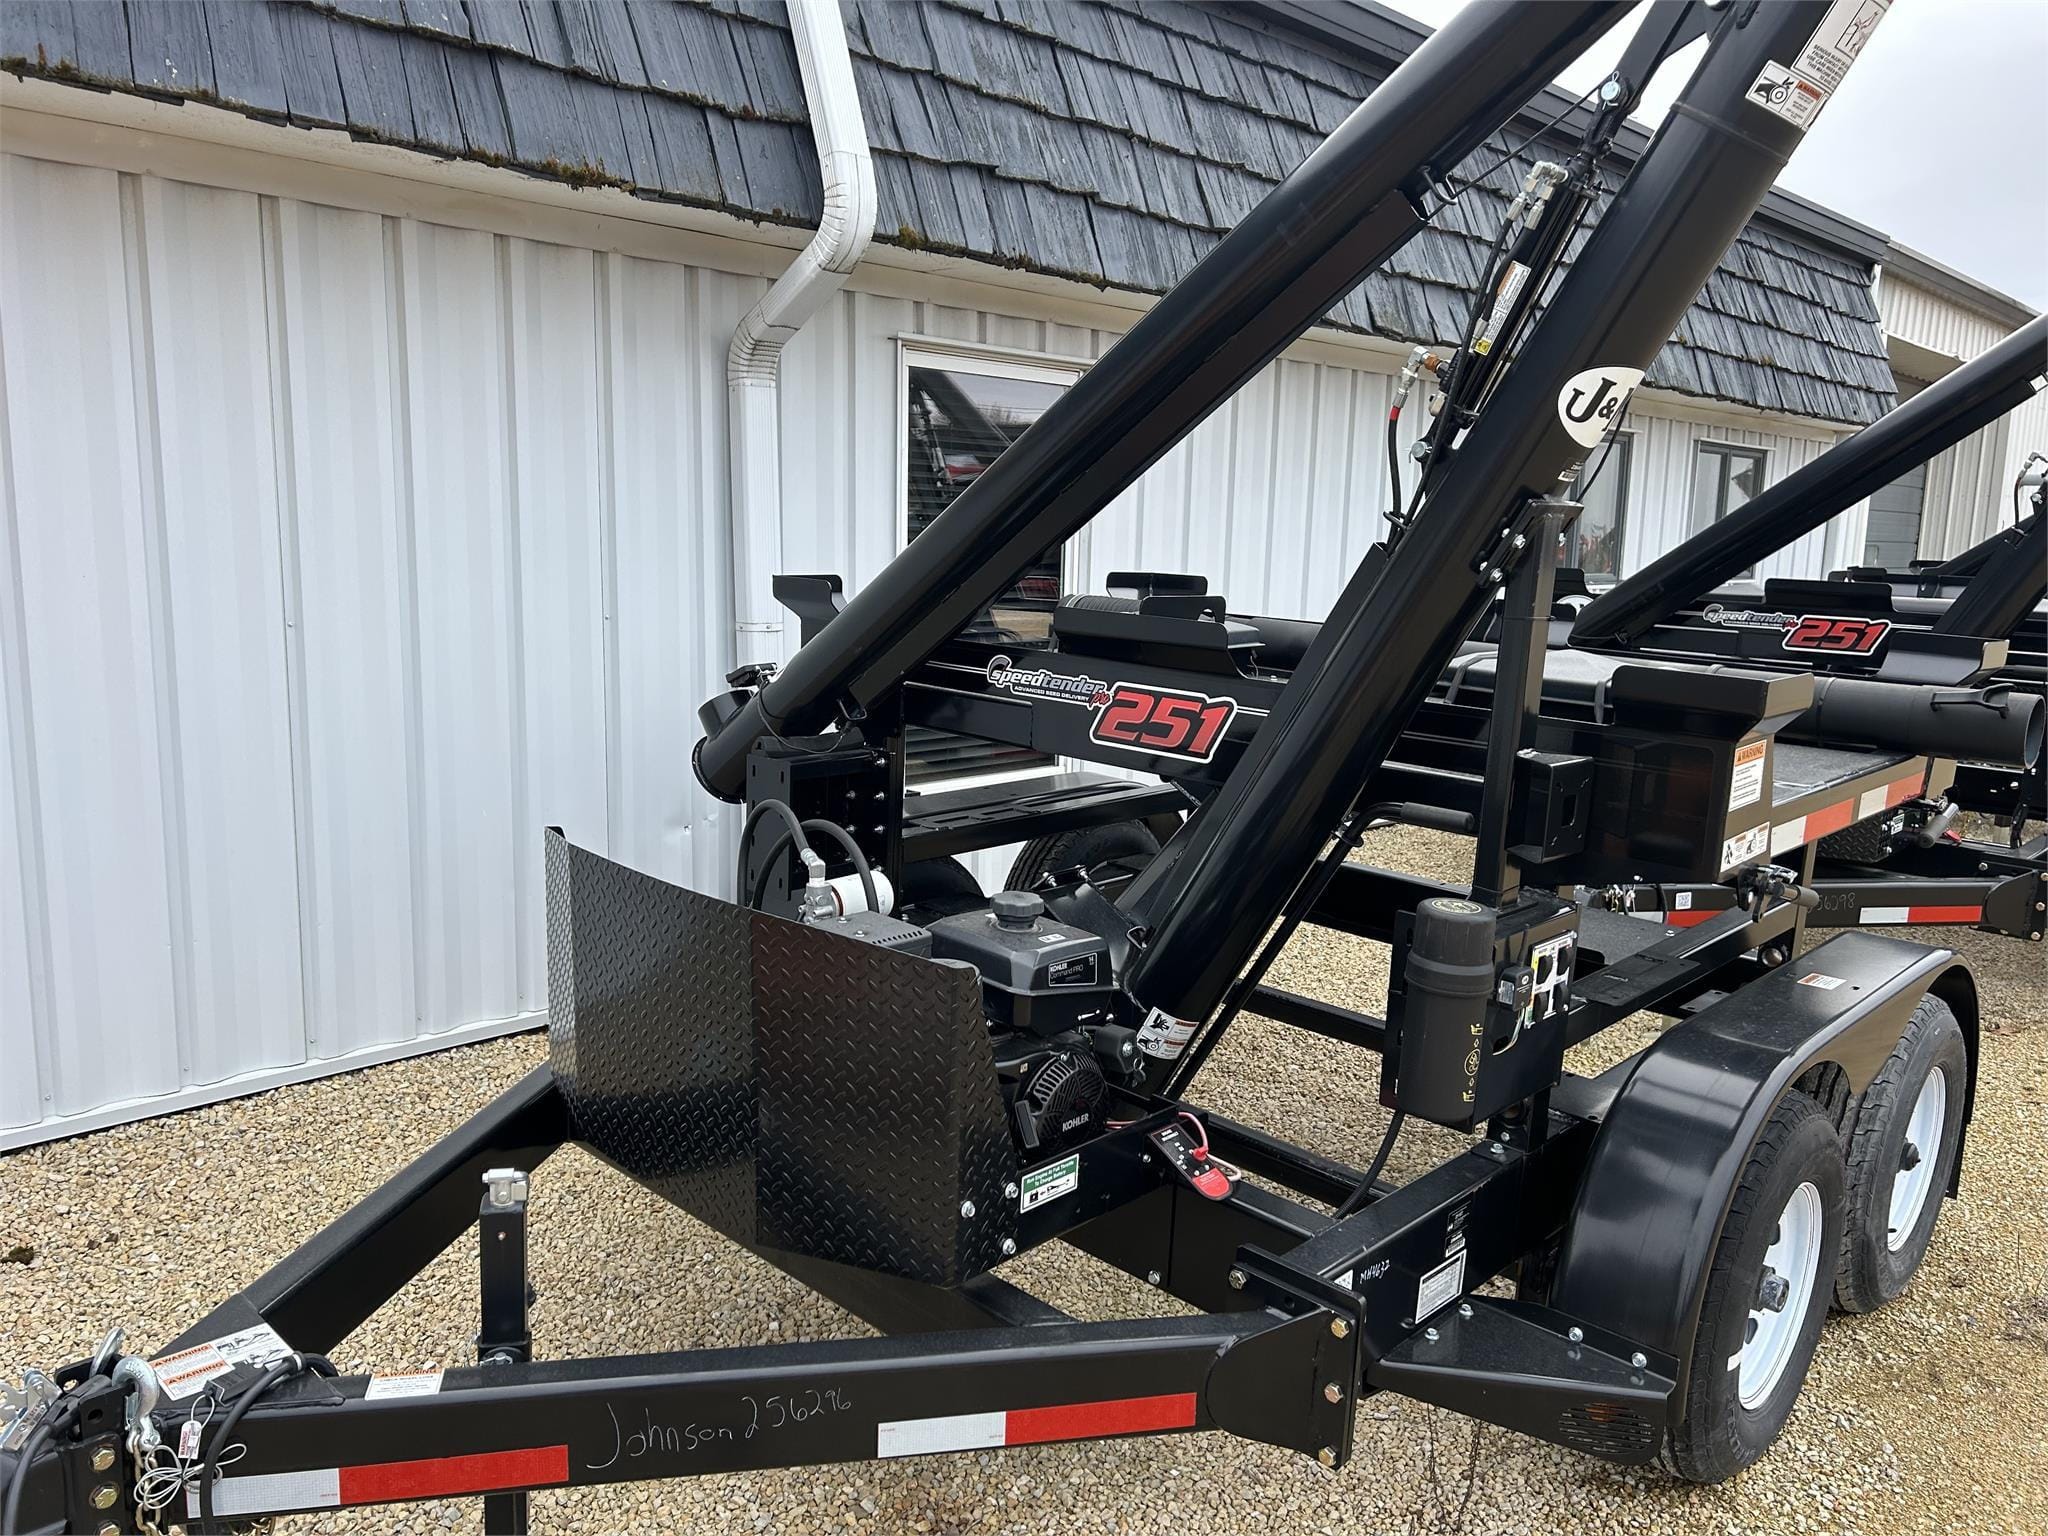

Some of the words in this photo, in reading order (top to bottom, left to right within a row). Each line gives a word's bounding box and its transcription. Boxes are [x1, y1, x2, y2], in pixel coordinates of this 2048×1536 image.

[1786, 619, 1887, 651] 251
[1014, 685, 1046, 695] ADVANCED
[1061, 691, 1090, 702] DELIVERY
[1096, 690, 1230, 754] 251
[1062, 1113, 1089, 1132] KOHLER
[162, 1345, 210, 1364] WARNING
[176, 1361, 225, 1382] WARNING
[585, 1401, 733, 1469] Johnson
[741, 1386, 852, 1440] 256296
